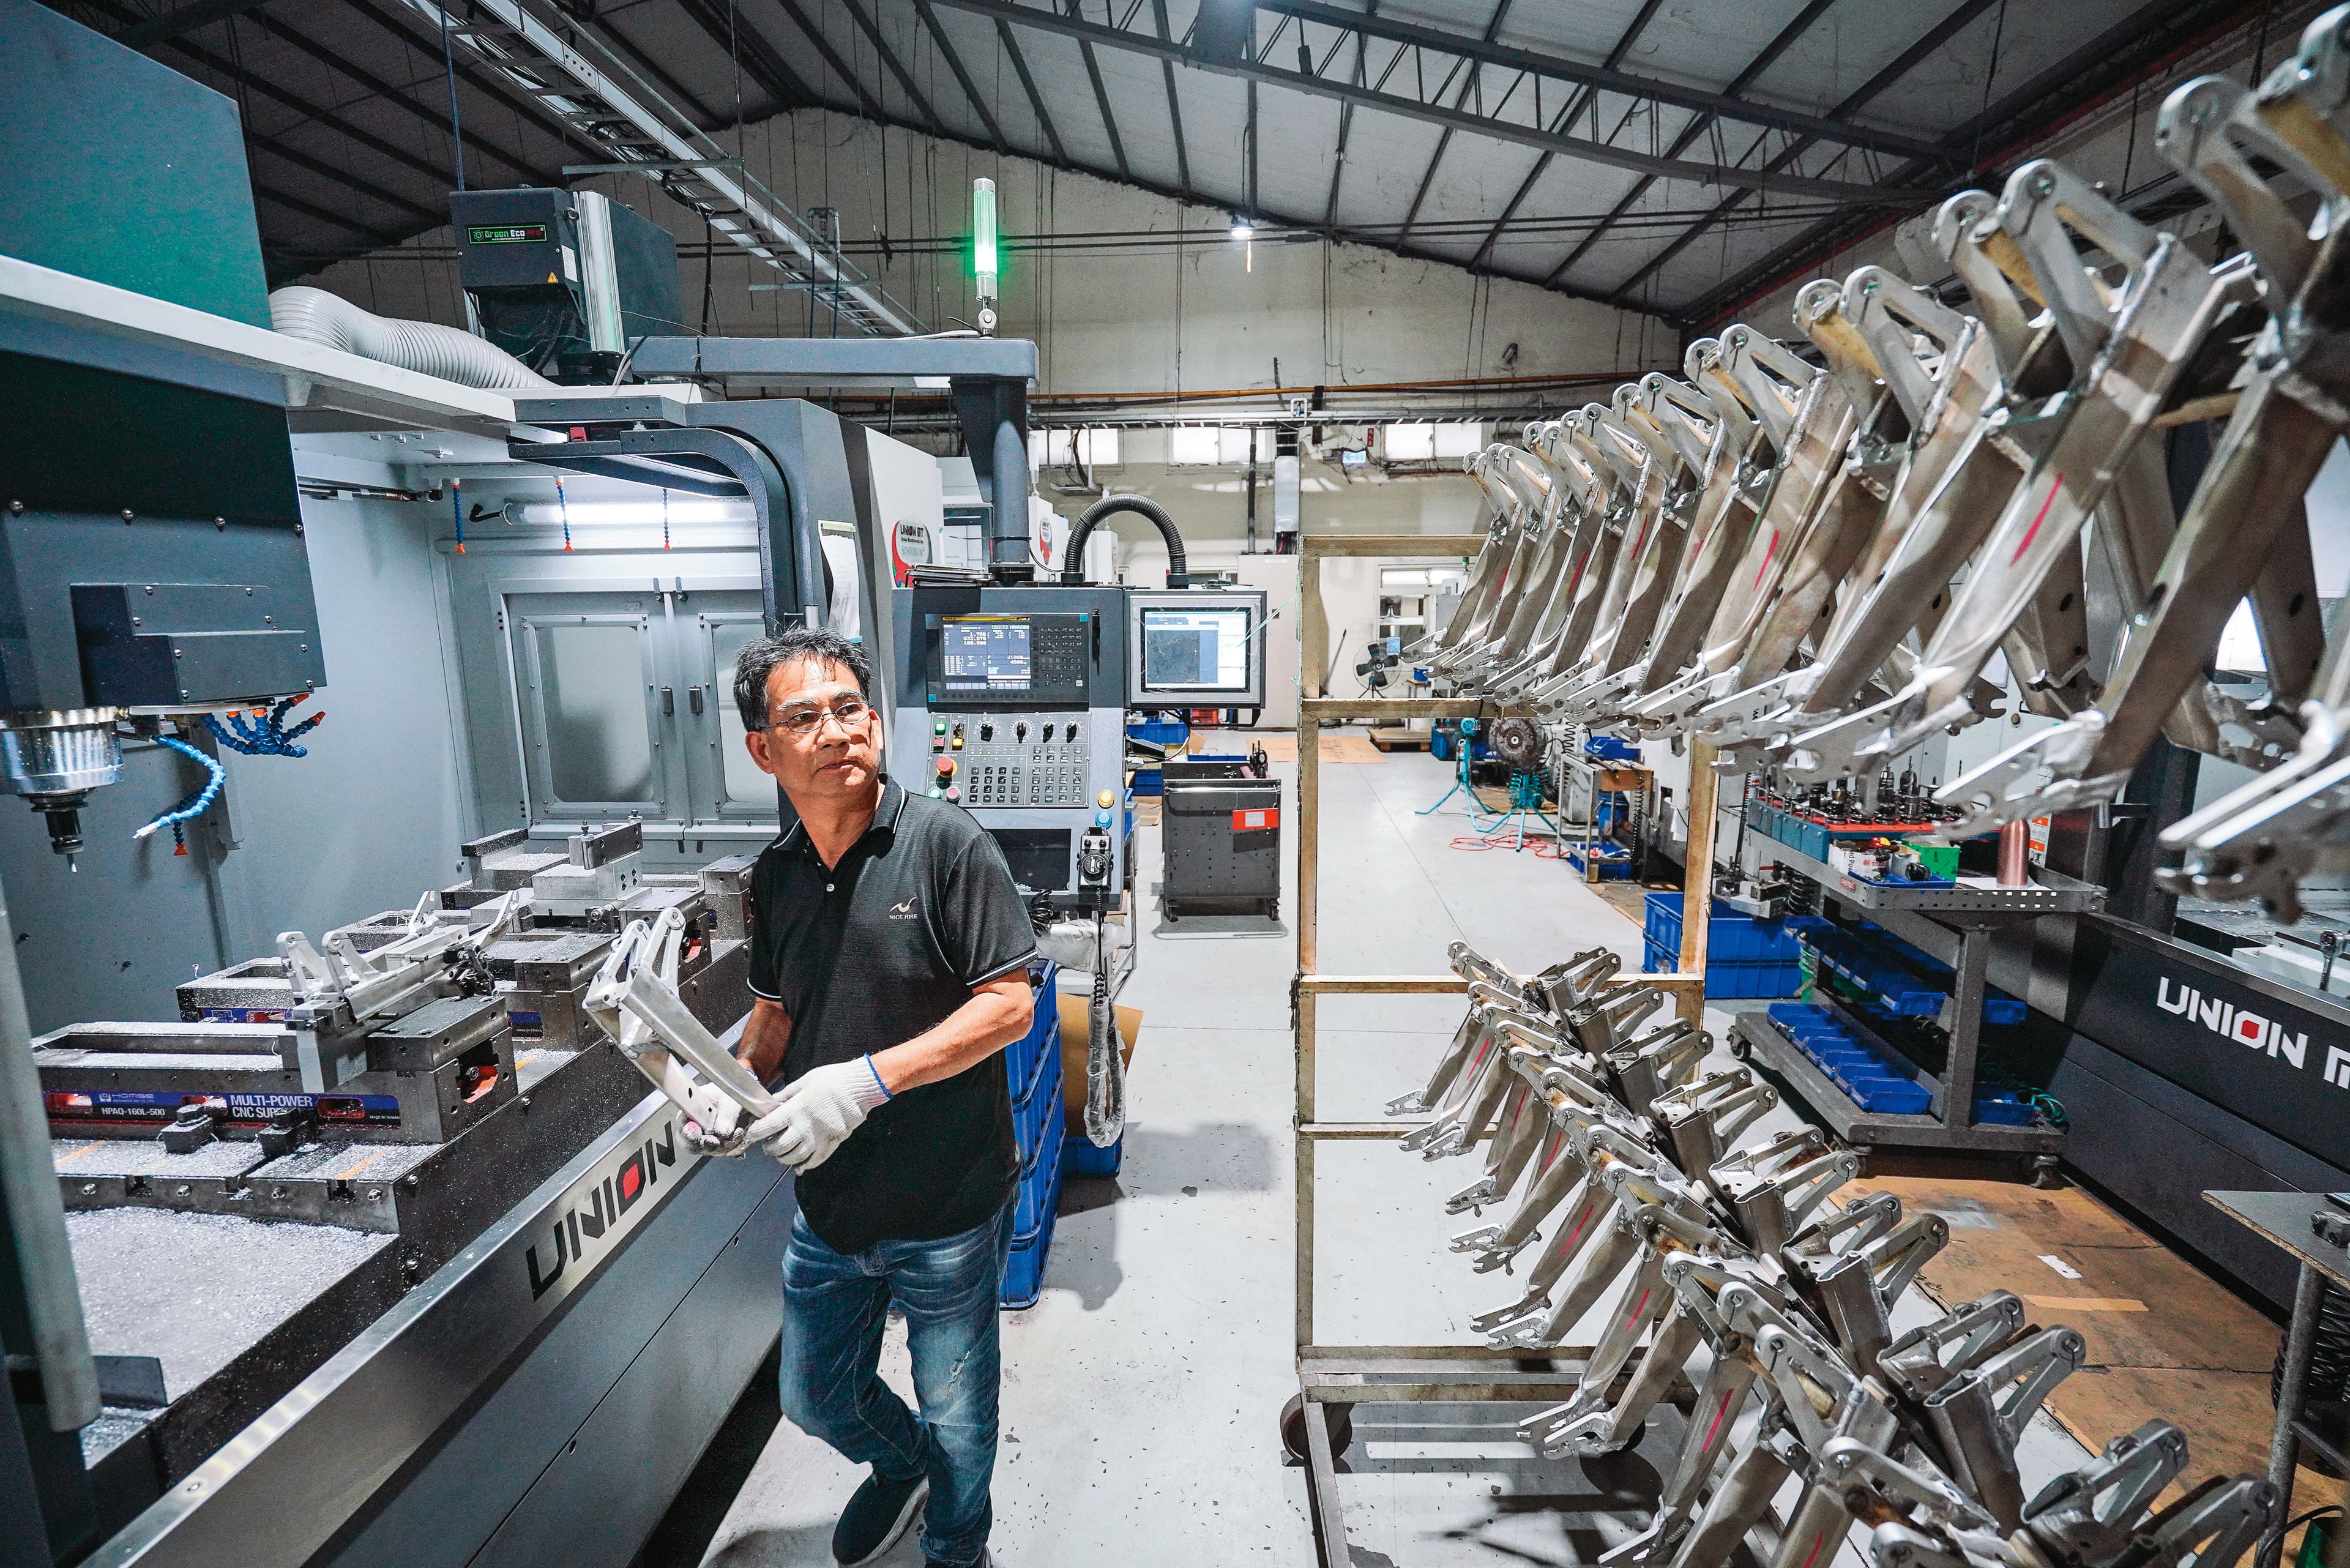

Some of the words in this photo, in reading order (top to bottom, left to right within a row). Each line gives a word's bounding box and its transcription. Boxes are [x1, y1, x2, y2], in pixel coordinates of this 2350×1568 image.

[900, 524, 916, 536] UNION
[2157, 976, 2308, 1070] UNION
[231, 1094, 312, 1107] MULTI-POWER
[102, 1107, 165, 1116] HPAQ-160L-500
[232, 1107, 255, 1118] CNC
[526, 1121, 676, 1302] UNION
